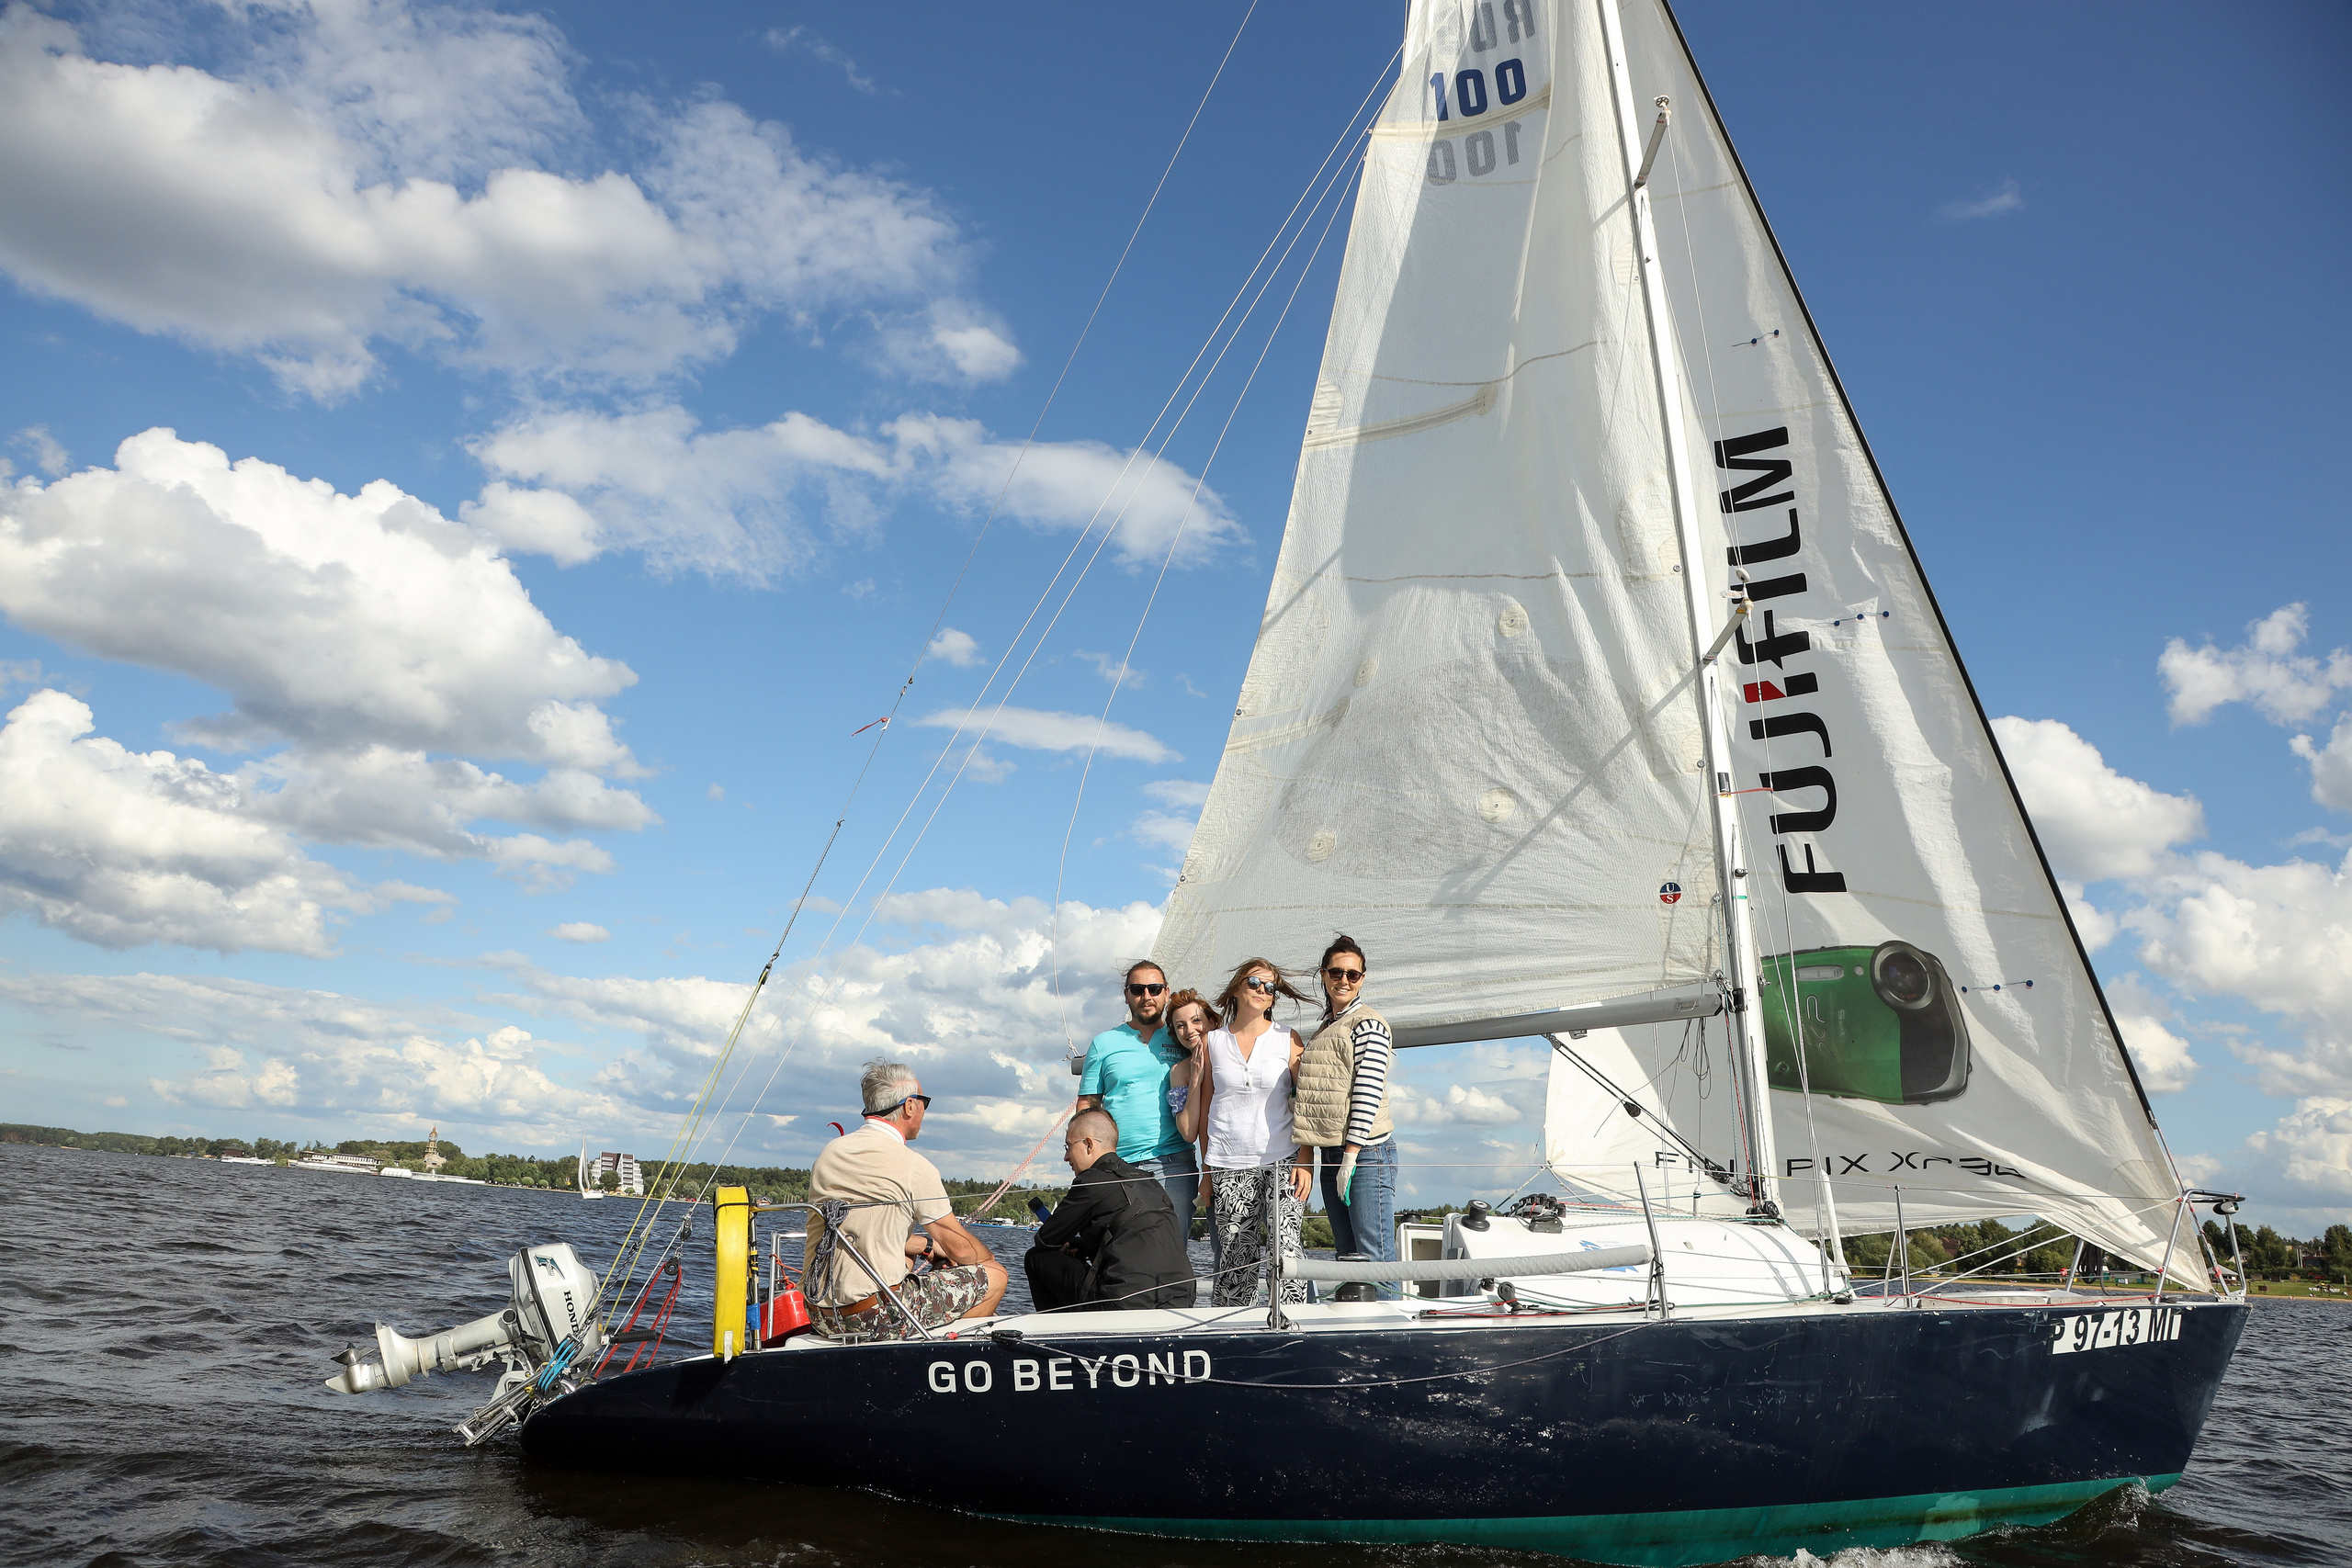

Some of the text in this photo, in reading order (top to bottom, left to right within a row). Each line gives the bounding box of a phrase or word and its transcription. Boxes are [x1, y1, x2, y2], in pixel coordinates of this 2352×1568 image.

[1430, 58, 1527, 121] 100
[1714, 426, 1848, 894] FUJIFILM
[563, 1290, 580, 1335] HOND
[2073, 1309, 2142, 1351] 97-13
[927, 1349, 1212, 1393] GO BEYOND
